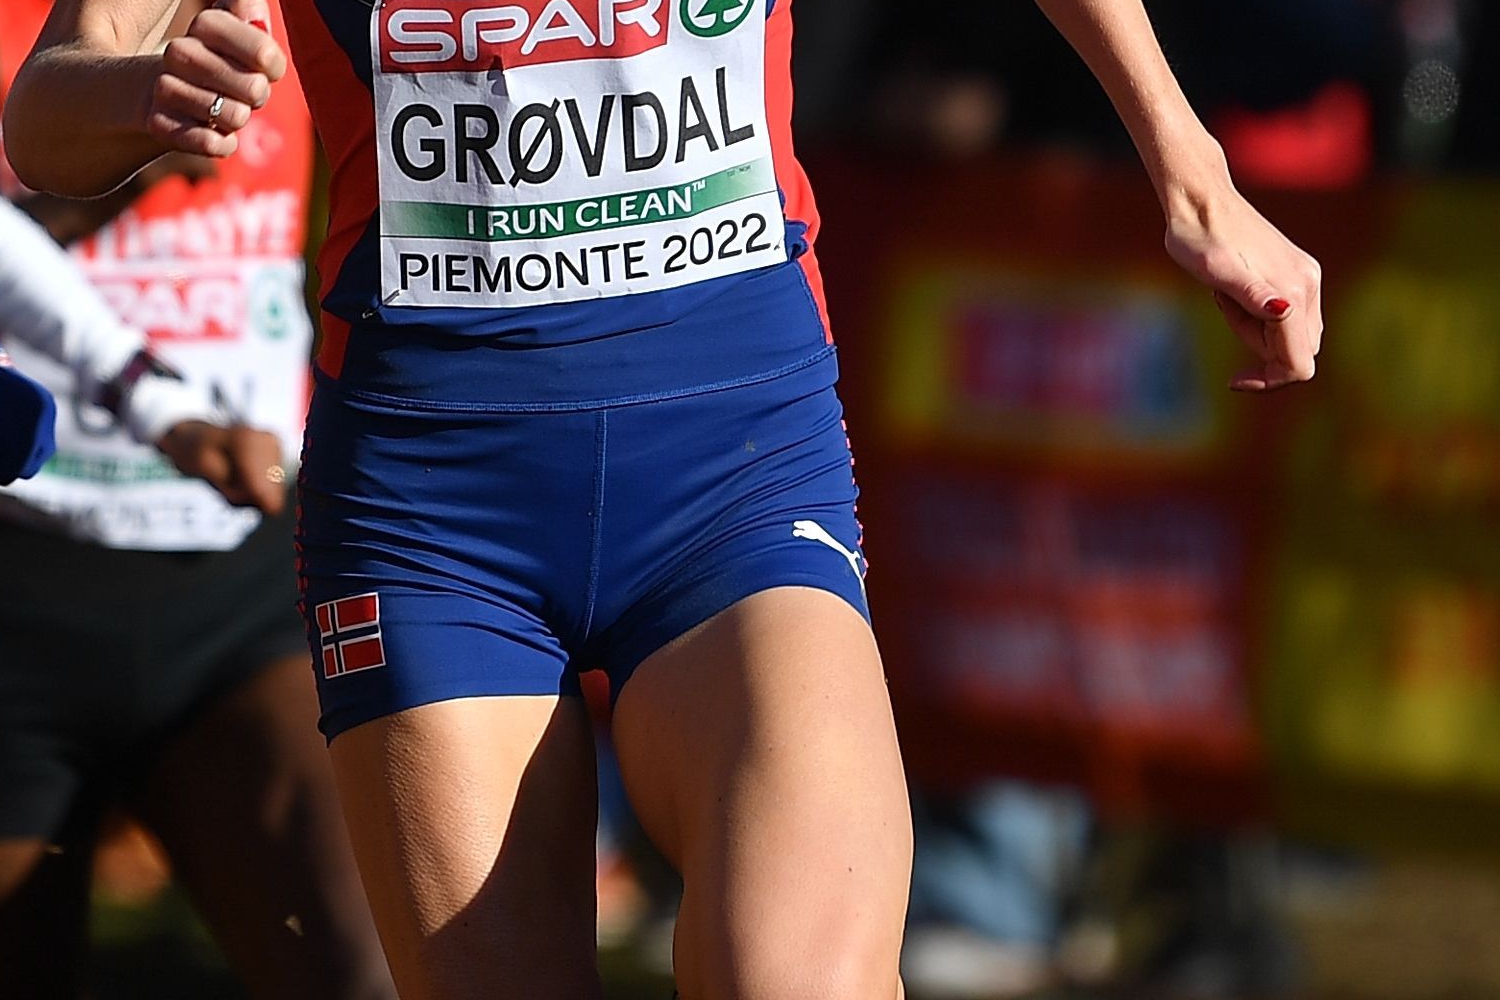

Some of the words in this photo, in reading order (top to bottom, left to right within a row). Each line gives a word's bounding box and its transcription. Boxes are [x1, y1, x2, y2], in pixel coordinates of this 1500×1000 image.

[389, 65, 756, 189] GRØVDAL
[400, 239, 649, 293] PIEMONTE
[662, 212, 770, 274] 2022
[467, 208, 476, 236] I
[487, 203, 565, 237] RUN
